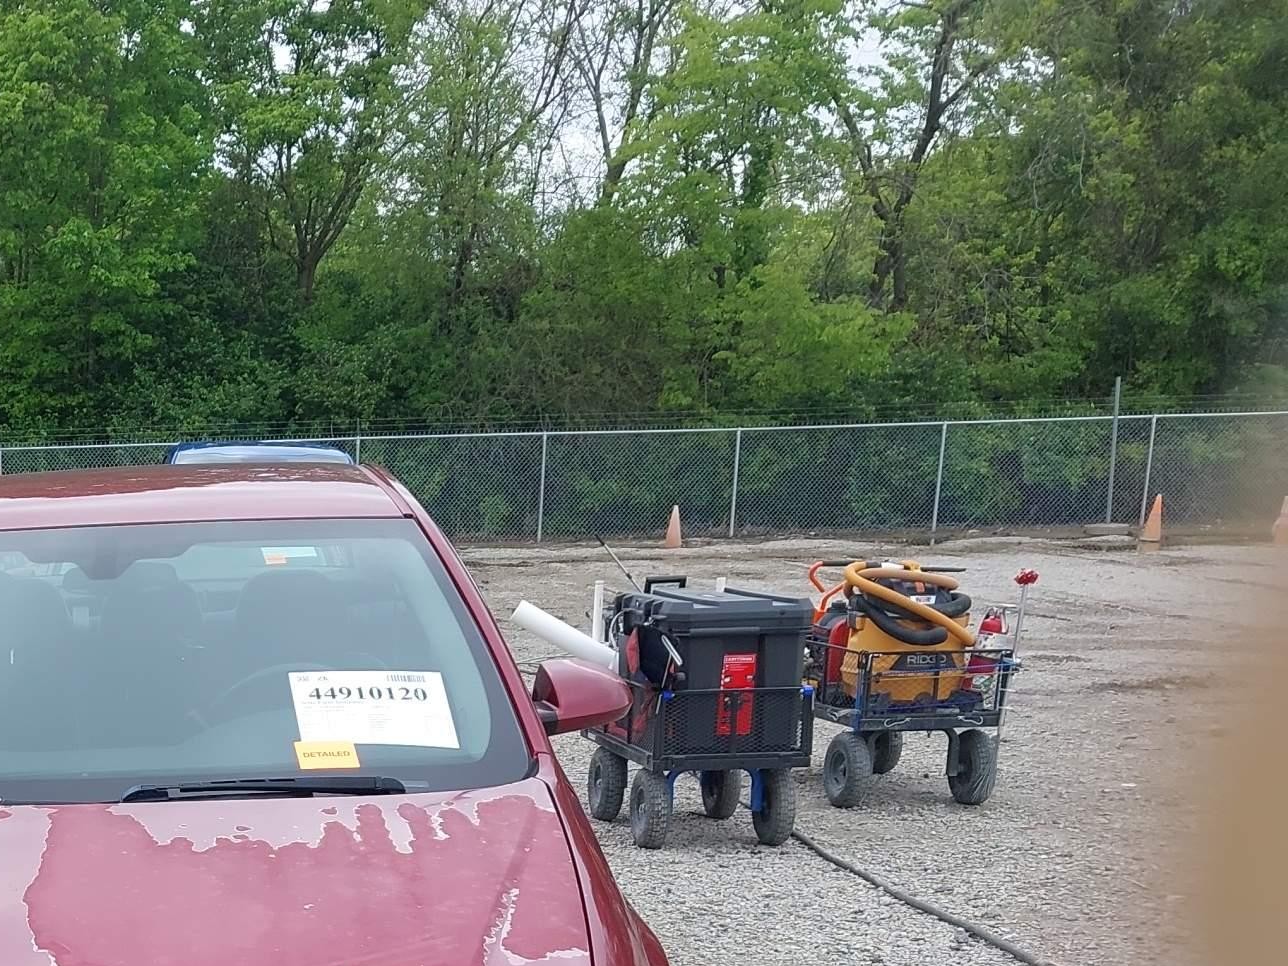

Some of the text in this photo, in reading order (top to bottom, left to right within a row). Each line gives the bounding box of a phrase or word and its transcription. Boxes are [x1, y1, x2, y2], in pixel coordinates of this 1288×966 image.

[907, 655, 946, 665] RIDGD
[309, 686, 428, 702] 44910120
[303, 749, 351, 759] DETAILED
